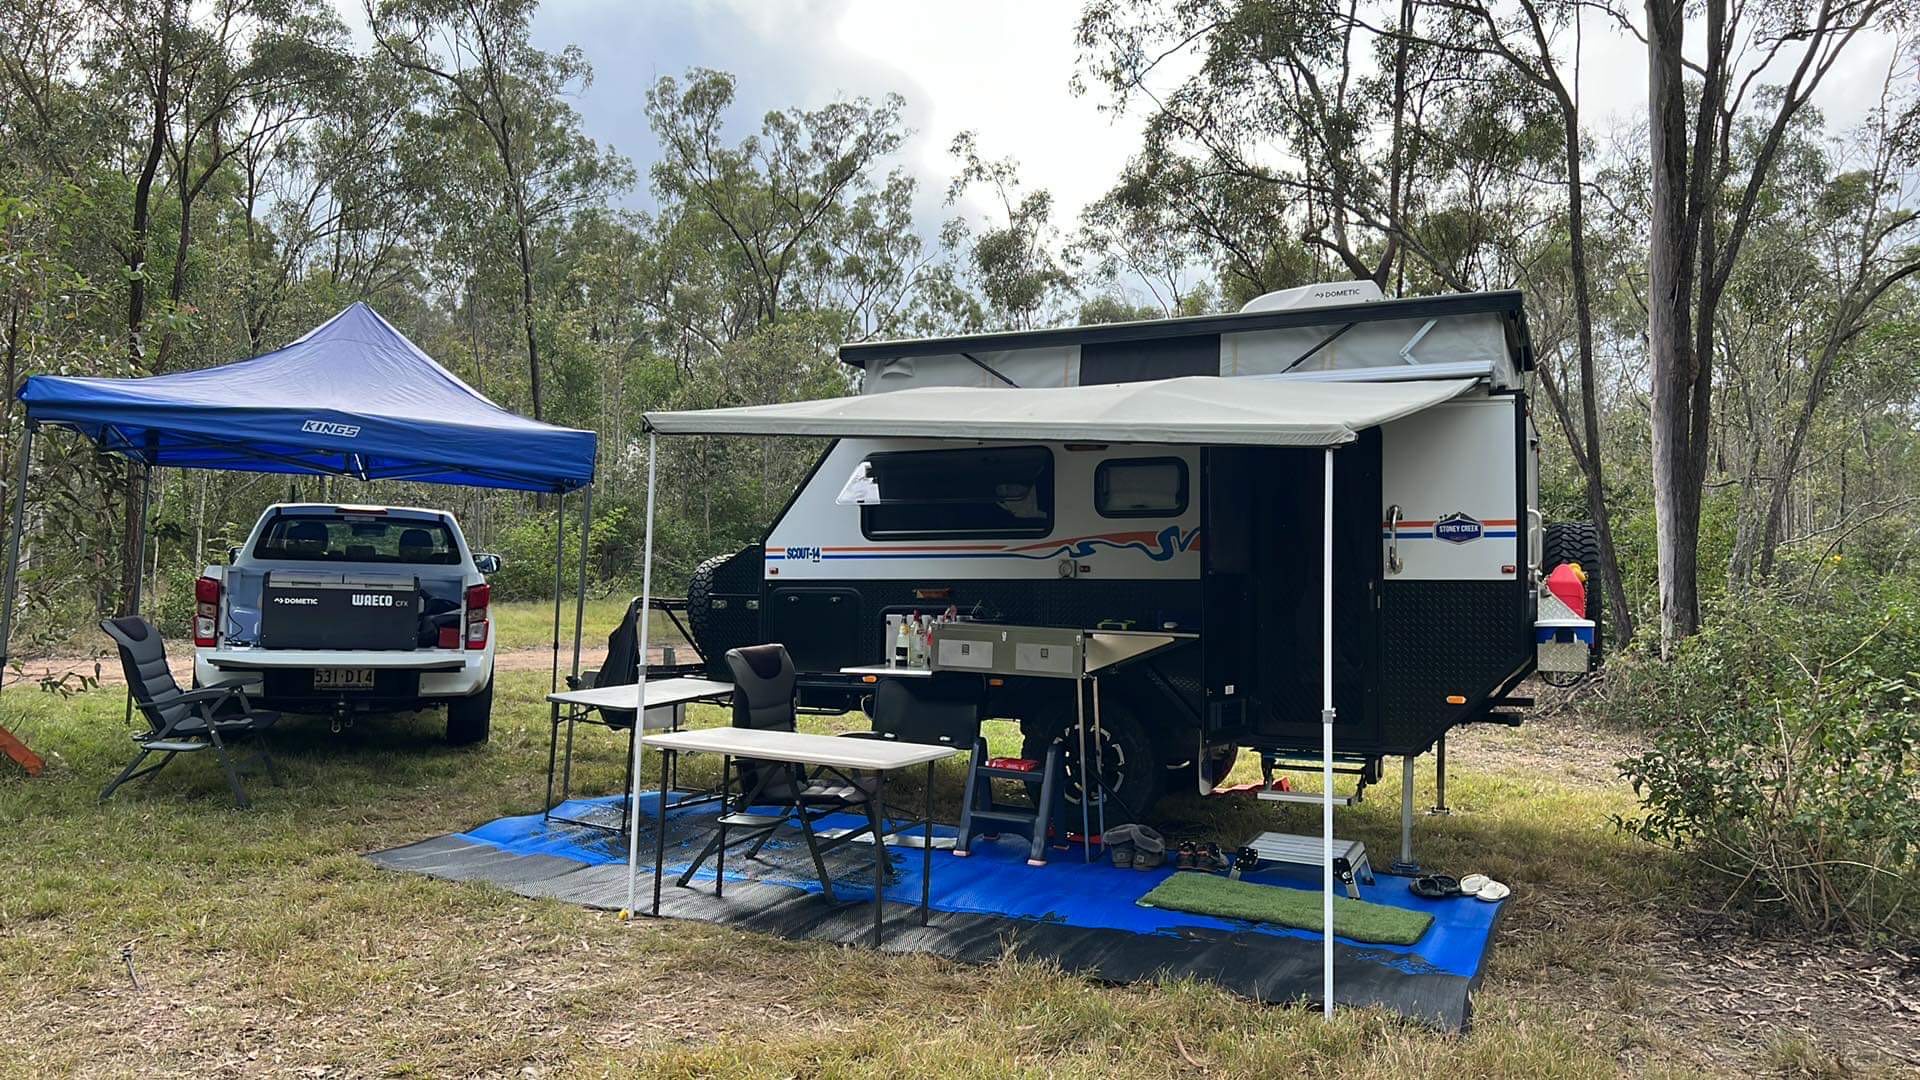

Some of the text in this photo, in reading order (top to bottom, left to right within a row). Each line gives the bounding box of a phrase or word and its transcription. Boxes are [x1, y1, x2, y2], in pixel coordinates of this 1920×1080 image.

[1325, 289, 1360, 298] DOMETIC
[302, 420, 360, 437] KINGS
[1439, 525, 1460, 533] STONEY
[352, 594, 392, 606] WAECO
